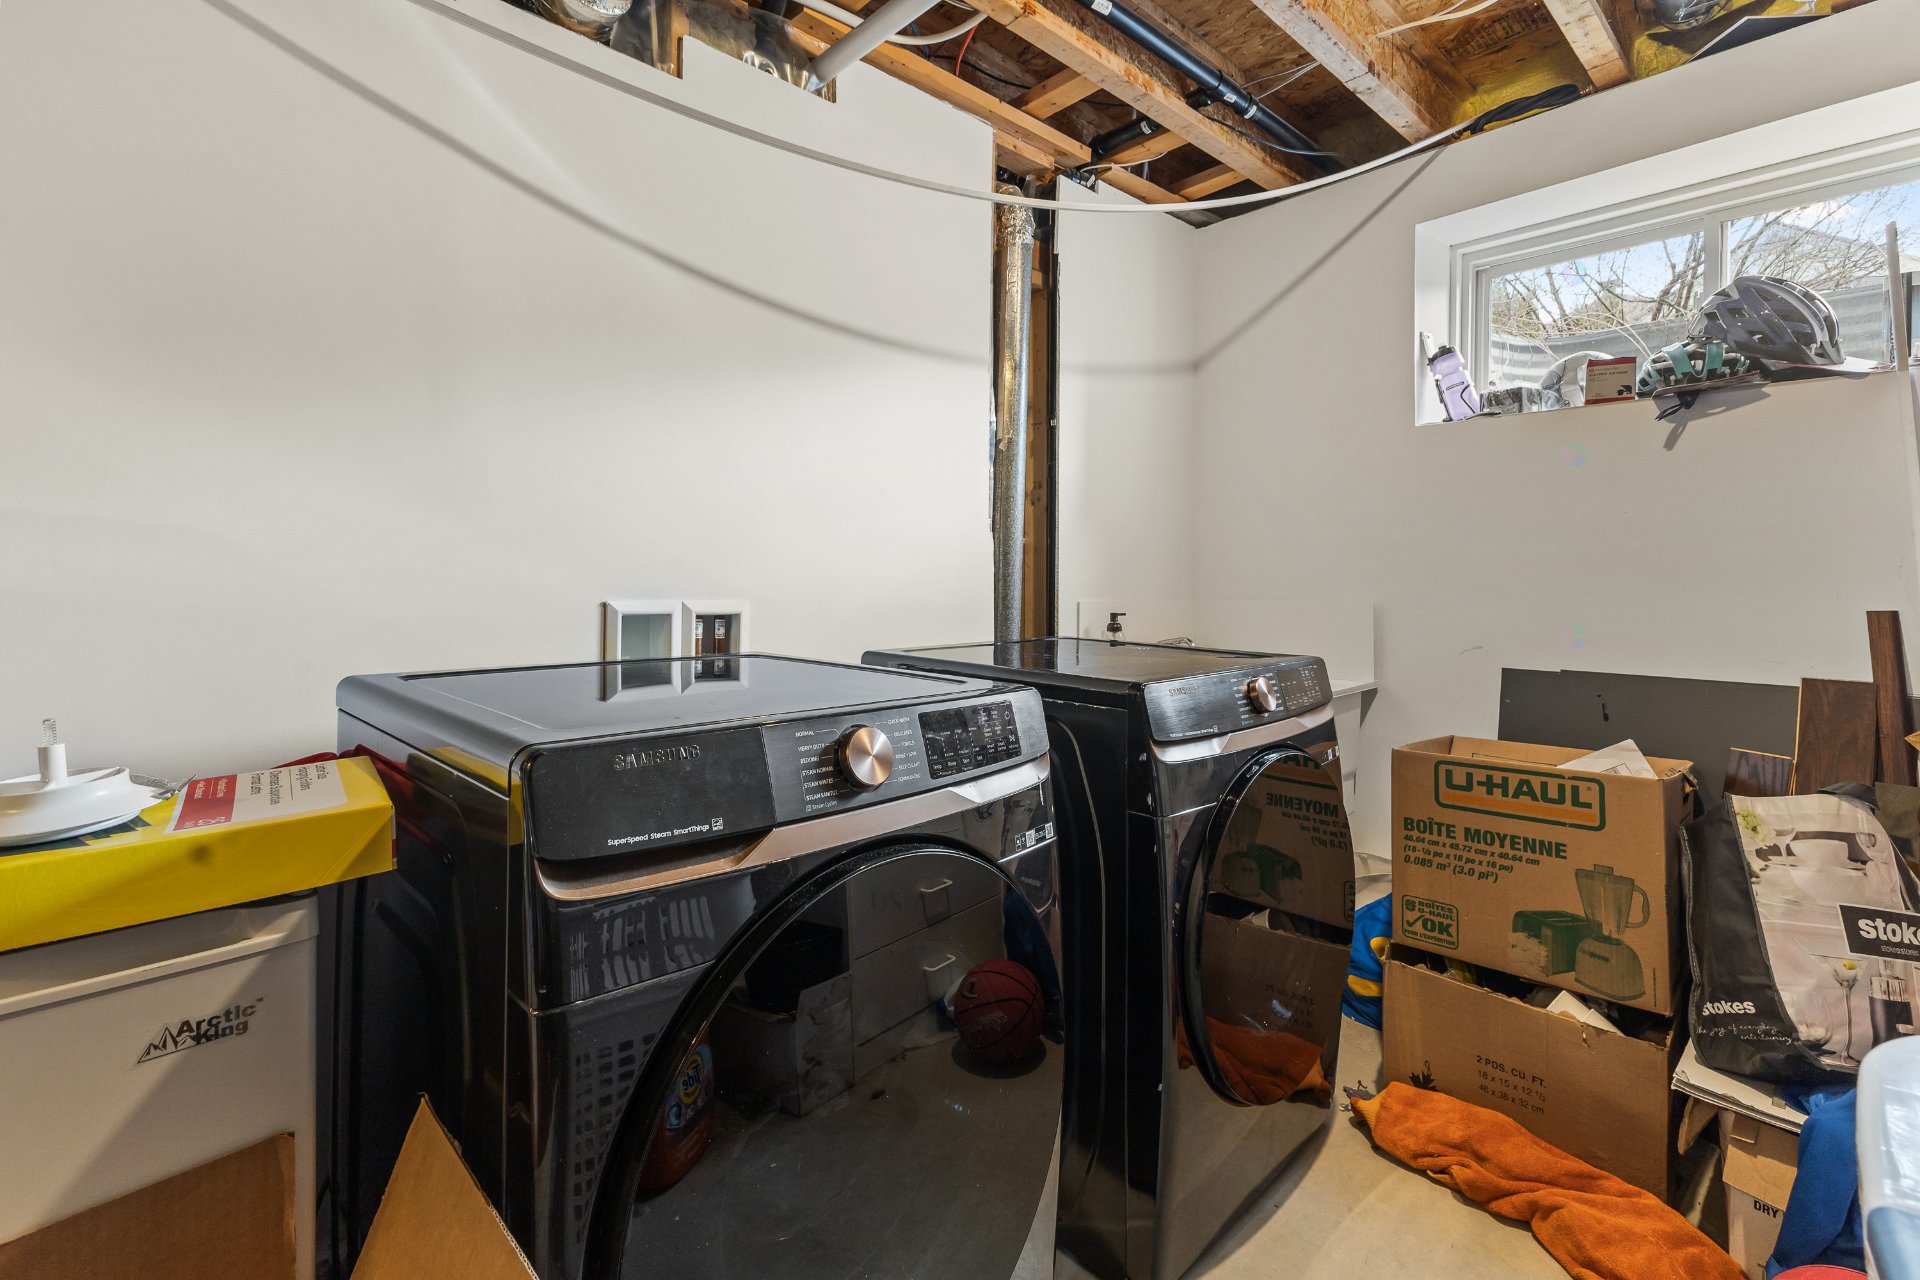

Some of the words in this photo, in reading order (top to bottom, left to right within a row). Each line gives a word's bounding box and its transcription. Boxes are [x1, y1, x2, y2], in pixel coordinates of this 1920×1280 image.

[614, 744, 700, 771] SAMSUNG
[1445, 769, 1593, 809] U-HAUL
[607, 834, 648, 846] SuperSpeed
[650, 831, 671, 840] Steam
[673, 824, 709, 836] SmartThings
[1403, 816, 1457, 840] BOÎTE
[1463, 827, 1567, 860] MOYENNE
[1403, 834, 1425, 844] 46.04
[1449, 843, 1473, 853] 45.72
[1474, 848, 1487, 856] cm
[1498, 852, 1523, 863] 40.64
[1525, 858, 1540, 866] cm
[1433, 850, 1443, 859] po
[1453, 853, 1463, 862] 18
[1465, 856, 1476, 865] po
[1486, 860, 1497, 869] 16
[1498, 862, 1513, 873] po)
[1404, 854, 1433, 868] 0.085
[1453, 864, 1475, 877] (3.0
[1421, 918, 1453, 938] OK
[1858, 918, 1920, 945] stok
[176, 1004, 257, 1038] Arctic
[1702, 1000, 1756, 1016] stokes
[196, 1020, 249, 1046] King
[1728, 1024, 1737, 1034] of
[1476, 1055, 1482, 1064] 2
[1484, 1057, 1508, 1074] PDS.
[1511, 1067, 1529, 1081] CU.
[1531, 1075, 1547, 1088] FT.
[1478, 1069, 1488, 1080] 18
[1500, 1078, 1510, 1088] 15
[1522, 1086, 1533, 1097] 12
[1479, 1084, 1489, 1094] 46
[1498, 1091, 1509, 1101] 38
[1518, 1098, 1529, 1109] 32
[1531, 1104, 1545, 1115] cm
[1753, 1199, 1779, 1219] DRY
